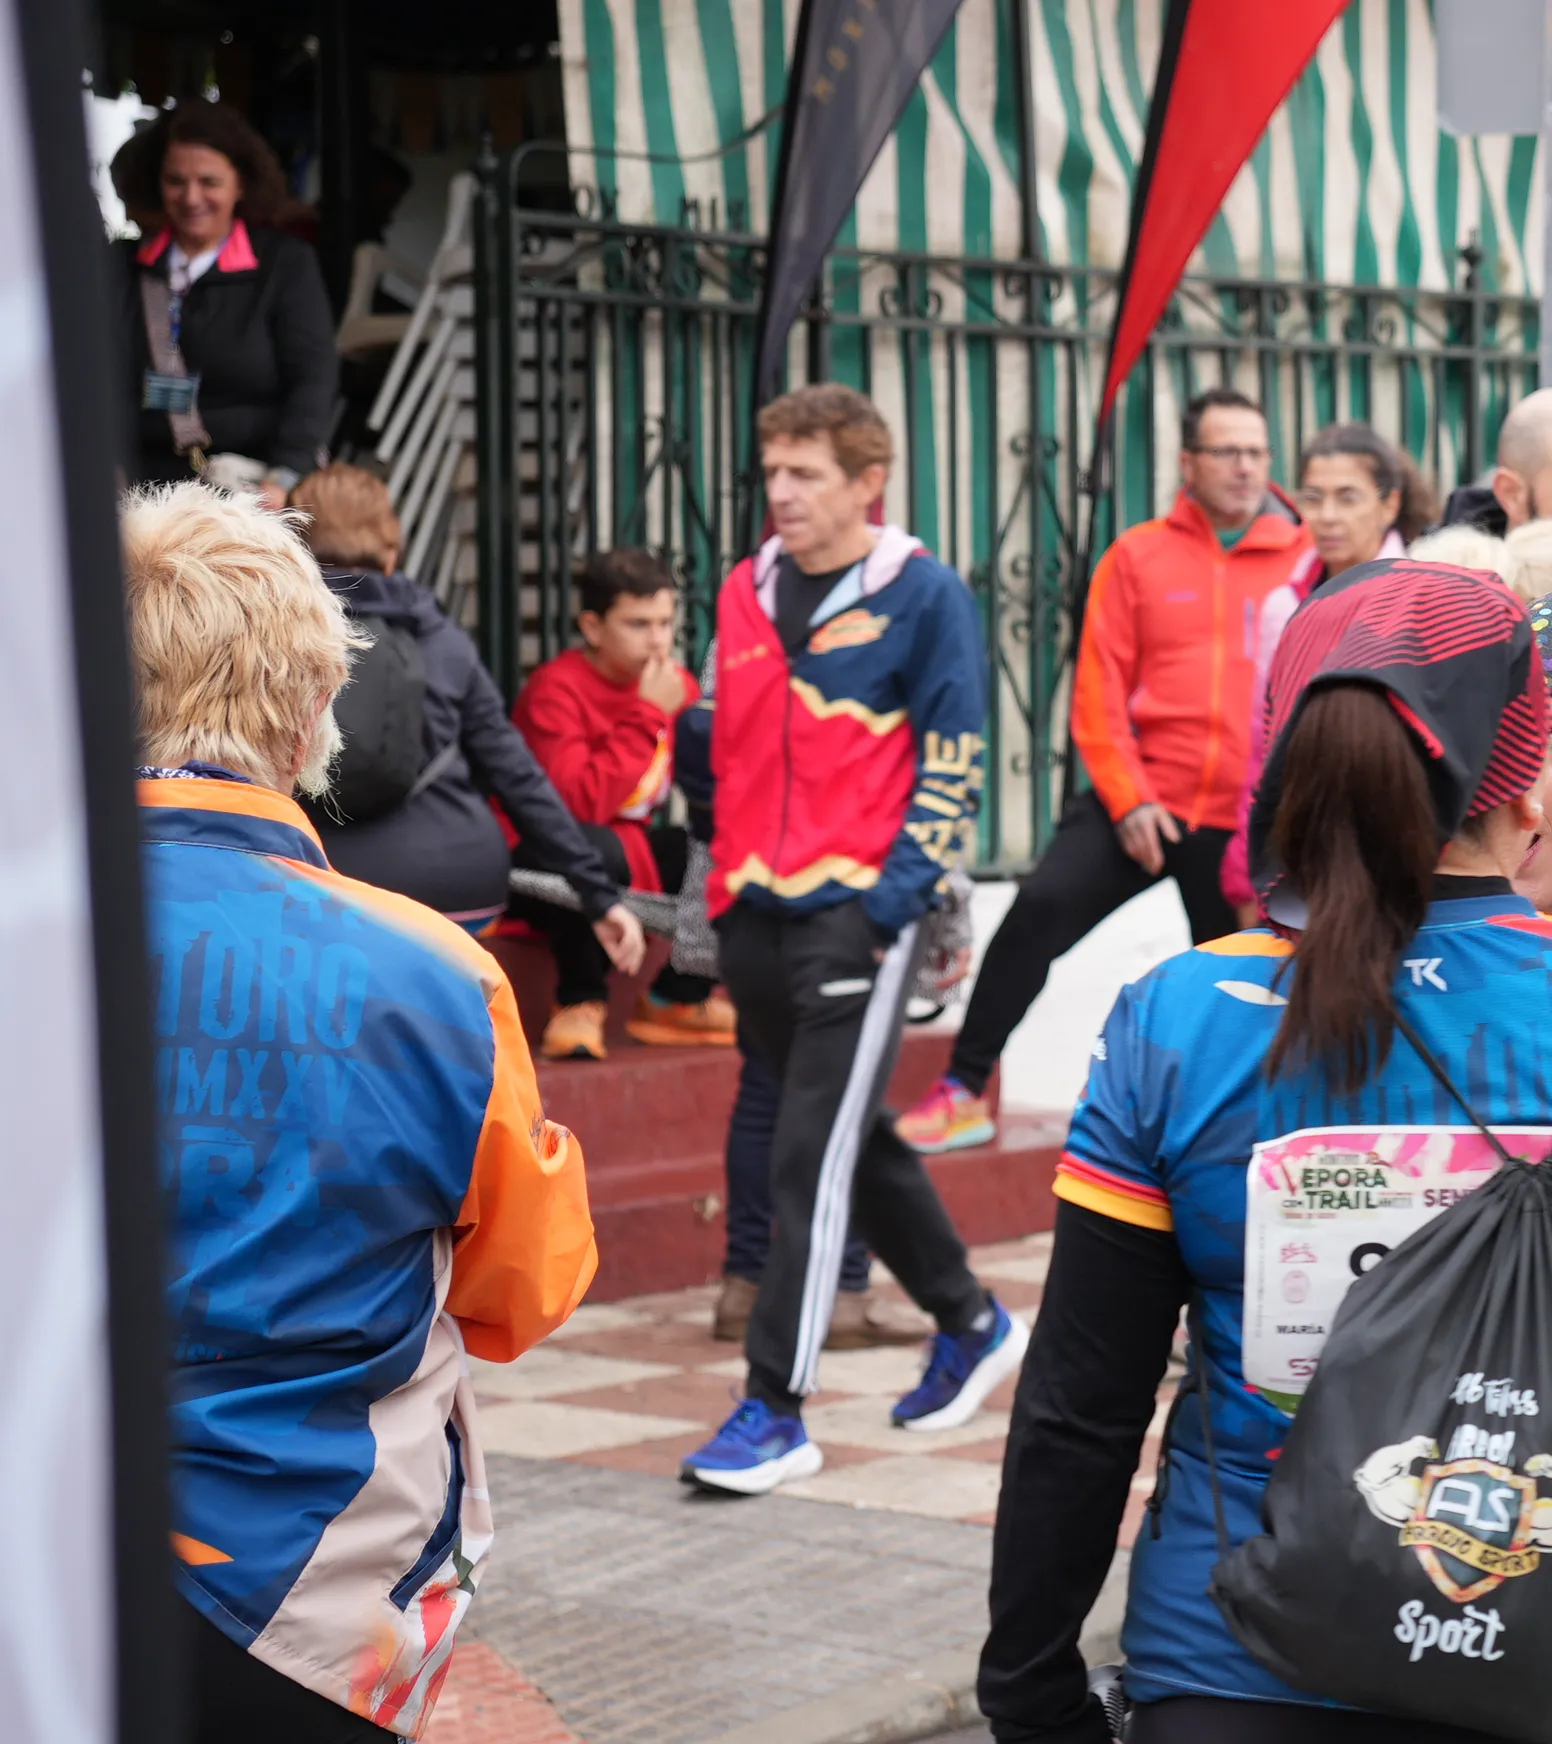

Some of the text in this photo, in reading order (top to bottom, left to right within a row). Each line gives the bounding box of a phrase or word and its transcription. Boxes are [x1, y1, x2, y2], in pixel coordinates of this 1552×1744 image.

[1302, 1167, 1387, 1189] EPORA
[1305, 1190, 1378, 1210] TRAIL
[1393, 1599, 1506, 1663] Sport
